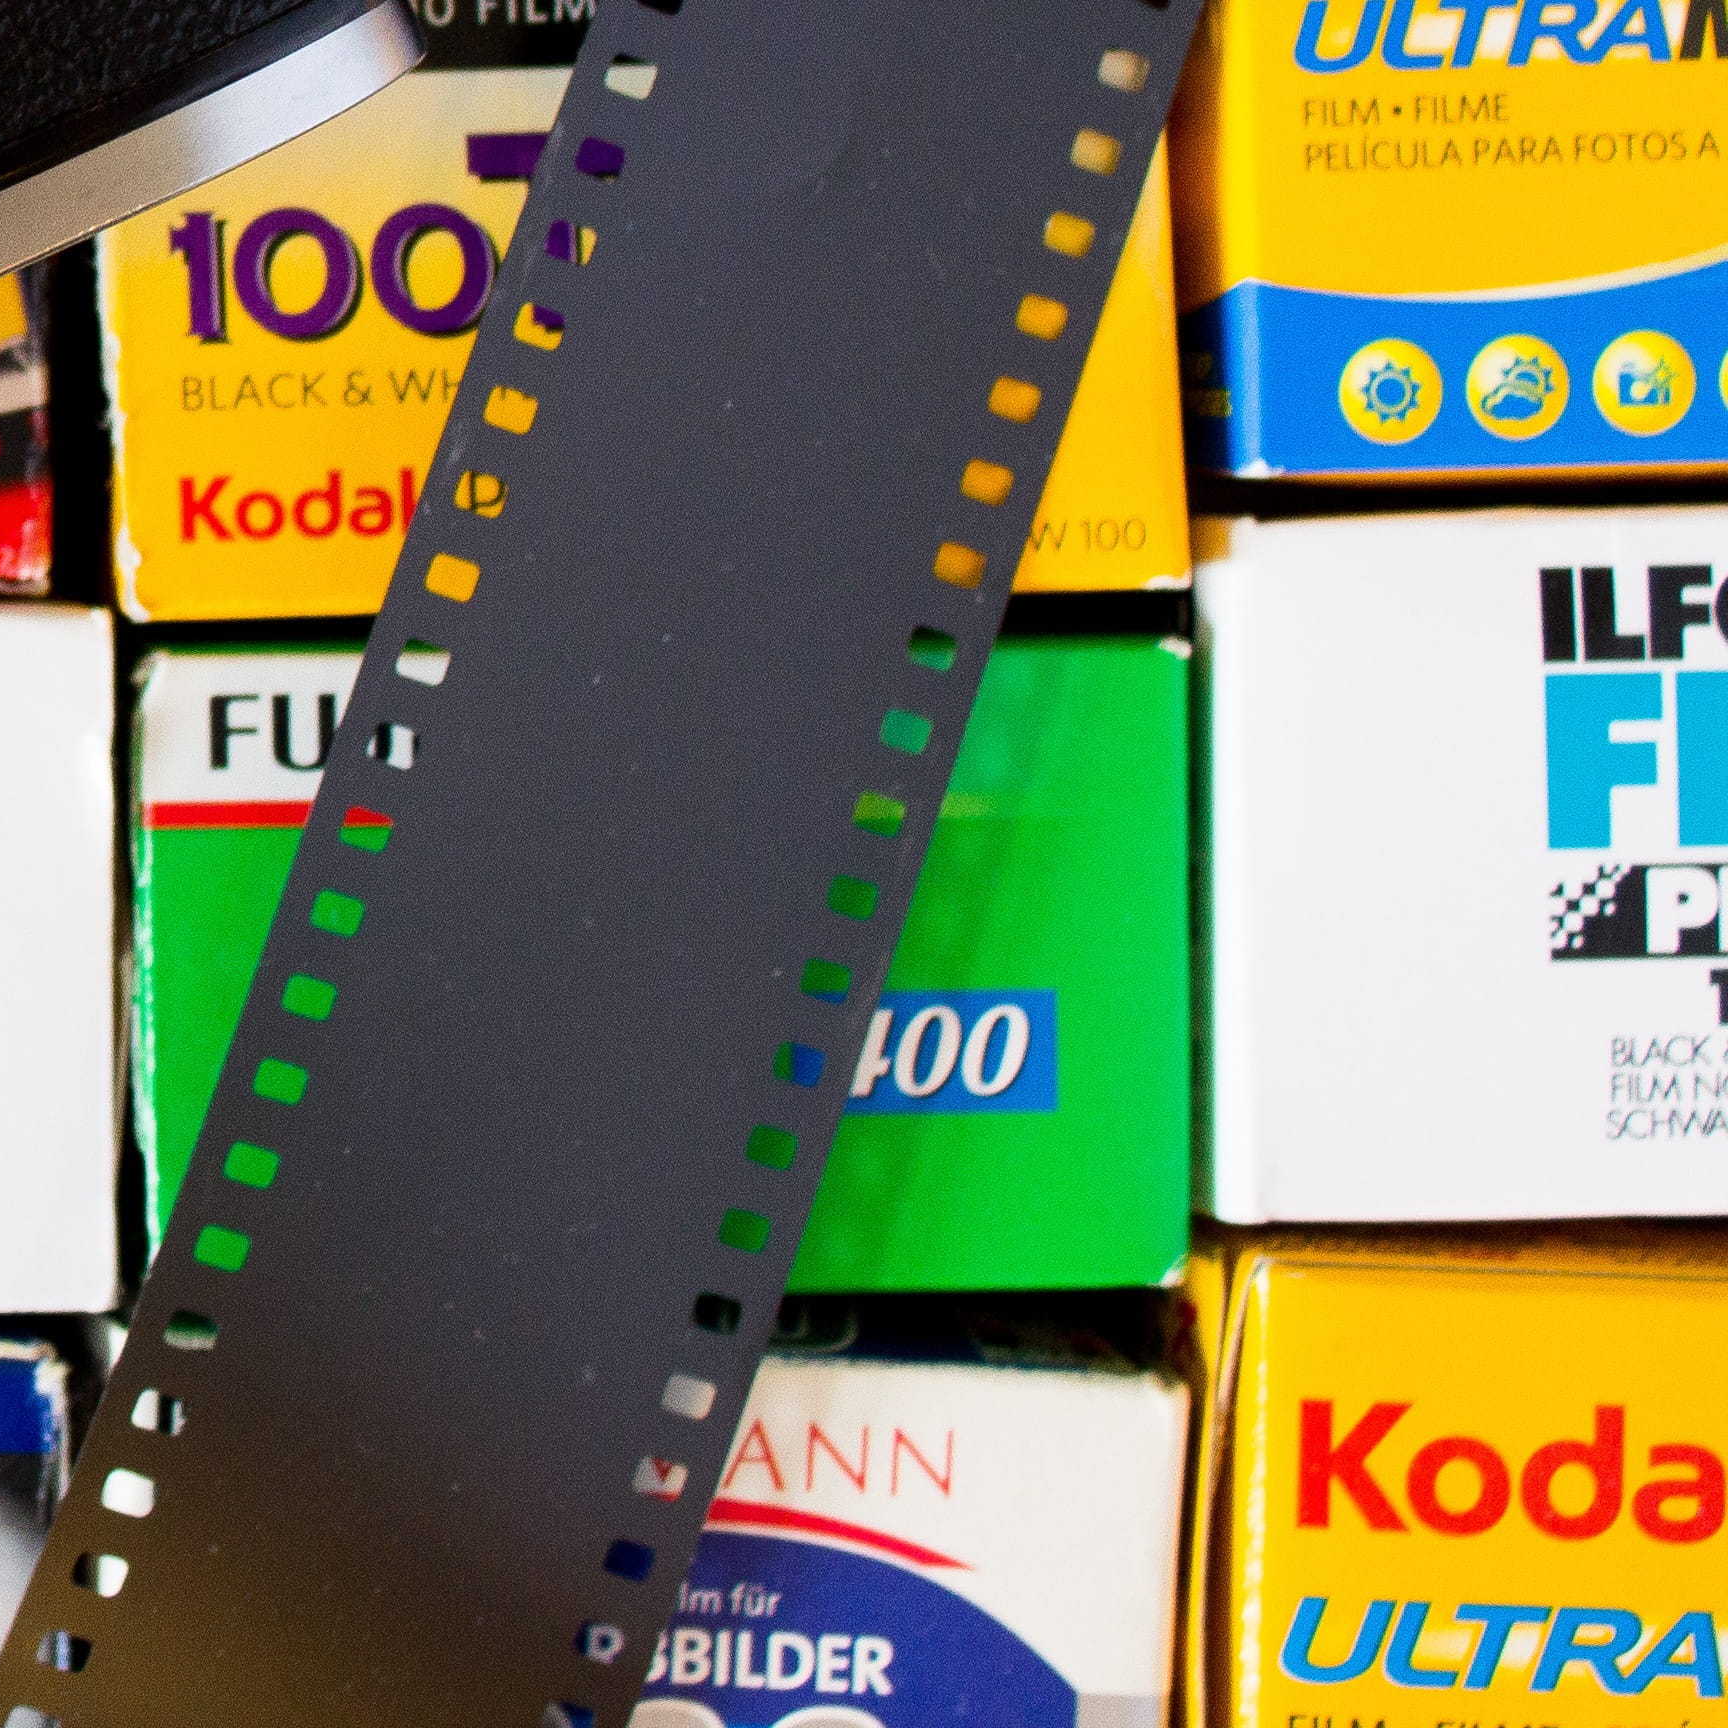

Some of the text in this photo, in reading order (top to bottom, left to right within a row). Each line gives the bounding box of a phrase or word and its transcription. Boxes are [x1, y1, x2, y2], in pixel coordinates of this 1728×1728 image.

[1303, 92, 1511, 128] FILM FILME
[1304, 128, 1722, 172] PELÍCULA PARA FOTOS A
[181, 370, 328, 412] BLACK
[343, 369, 374, 407] &
[1079, 516, 1147, 553] 100
